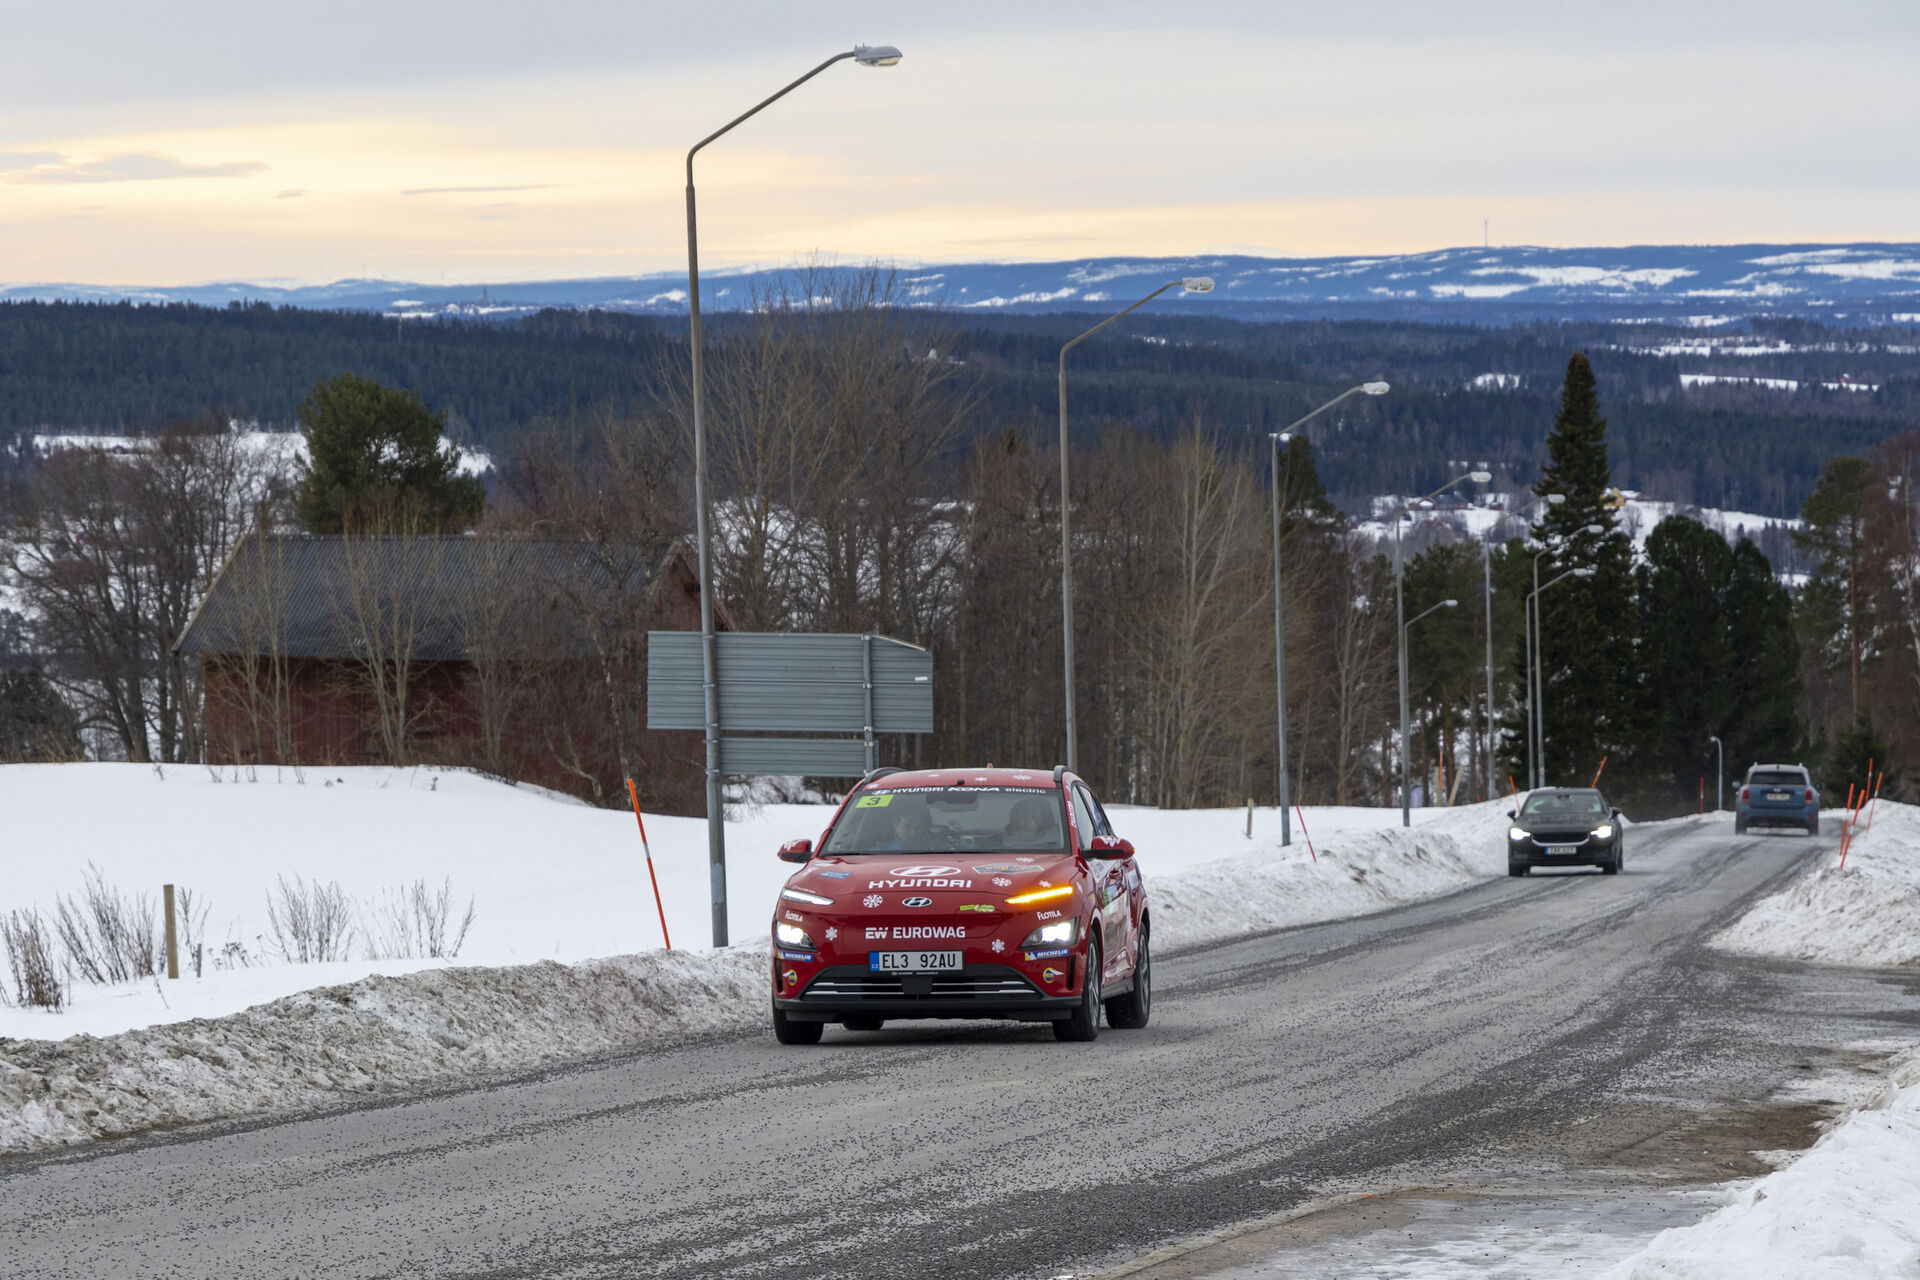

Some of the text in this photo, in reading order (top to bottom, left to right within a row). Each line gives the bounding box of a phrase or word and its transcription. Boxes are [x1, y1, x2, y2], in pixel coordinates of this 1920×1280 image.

[892, 786, 944, 794] HYUNDAI
[866, 796, 882, 806] 3
[868, 878, 972, 889] HYUNDAI
[1036, 910, 1062, 921] FLOTILA
[892, 926, 966, 939] EUROWAG
[1037, 948, 1068, 958] MICHELIN
[882, 953, 956, 969] EL3 92AU
